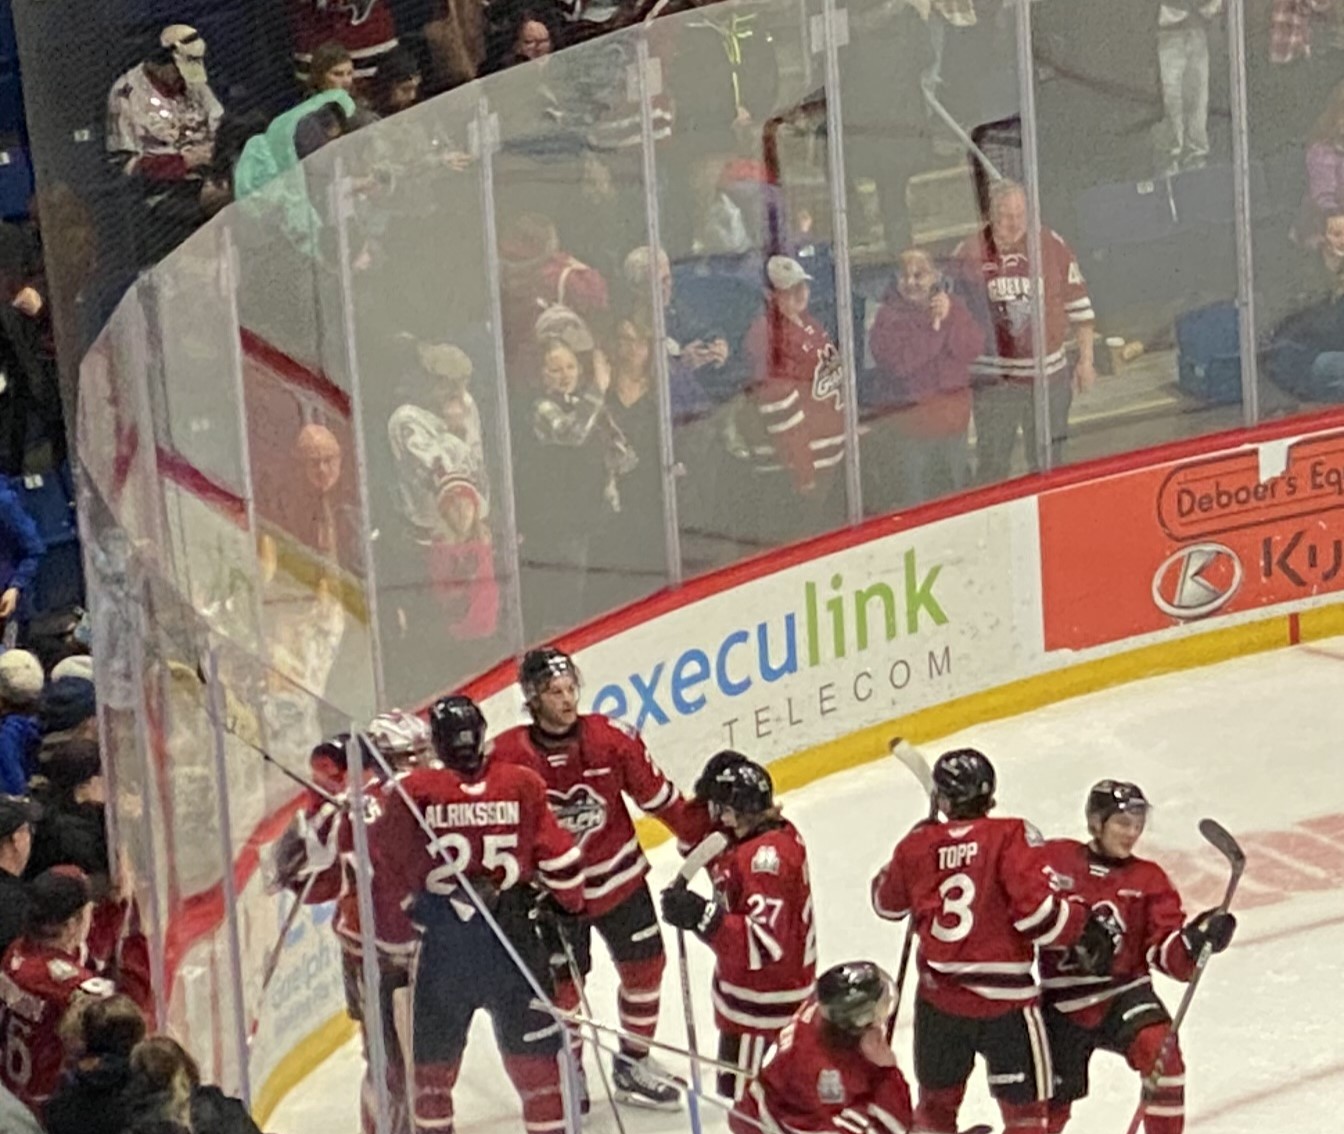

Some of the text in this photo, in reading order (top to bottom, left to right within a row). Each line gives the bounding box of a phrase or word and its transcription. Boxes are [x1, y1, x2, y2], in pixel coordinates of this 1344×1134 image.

[1176, 475, 1298, 519] Deboer's
[591, 547, 950, 734] execulink
[721, 645, 952, 749] TELECOM
[425, 801, 520, 829] ALRIKSSON
[425, 833, 521, 896] 25
[938, 841, 979, 870] TOPP
[747, 893, 784, 928] 27
[930, 872, 976, 942] 3
